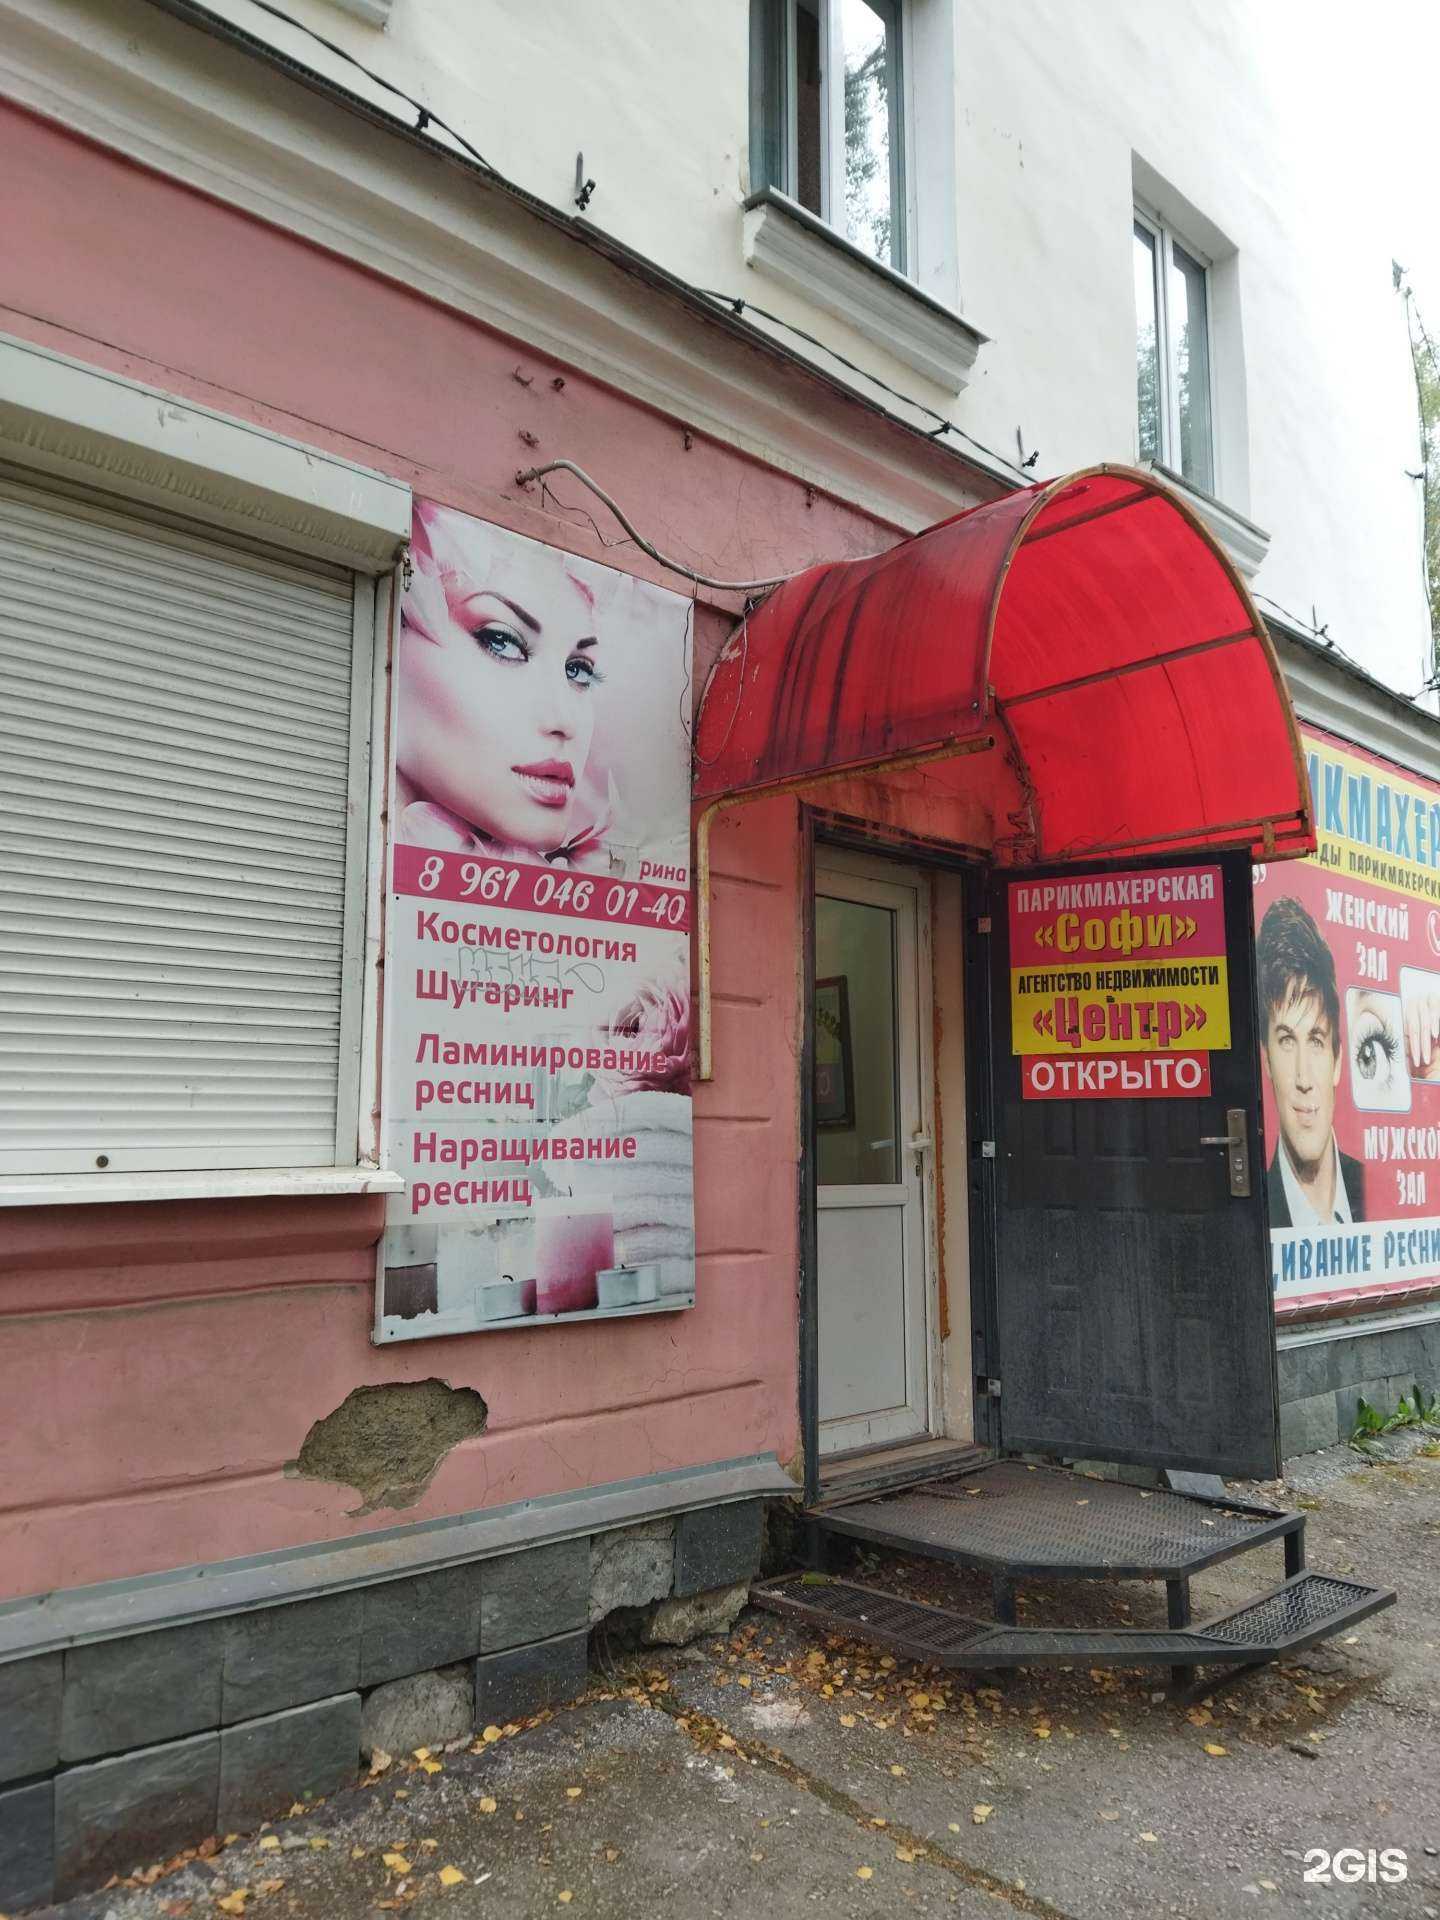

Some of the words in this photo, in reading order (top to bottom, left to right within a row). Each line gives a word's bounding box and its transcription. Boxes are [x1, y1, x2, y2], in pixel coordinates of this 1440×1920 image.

[418, 856, 445, 892] 8
[460, 863, 521, 901] 961
[533, 874, 595, 912] 046
[605, 885, 687, 924] 01-40
[640, 860, 687, 882] рина
[1349, 850, 1440, 898] ПАРИКМАХЕРСК
[1017, 873, 1214, 913] ПАРИКМАХЕРСКАЯ
[1034, 909, 1198, 955] «Софи»
[1326, 888, 1409, 941] ЖЕНСКИЙ
[417, 910, 637, 962] Косметология
[1018, 971, 1091, 994] АГЕНТСТВО
[1096, 966, 1219, 992] НЕДВИЖИМОСТИ
[1356, 941, 1388, 981] ЗАЛ
[416, 969, 574, 1012] Шугаринг
[1033, 997, 1207, 1048] «Центр»
[416, 1033, 667, 1075] Ламинирование
[1031, 1058, 1202, 1091] ОТКРЫТО
[416, 1078, 535, 1111] ресниц
[413, 1131, 637, 1169] Наращивание
[412, 1179, 533, 1214] ресниц
[1397, 1169, 1426, 1206] ЗАЛ
[1272, 1234, 1371, 1291] ИВАНИЕ
